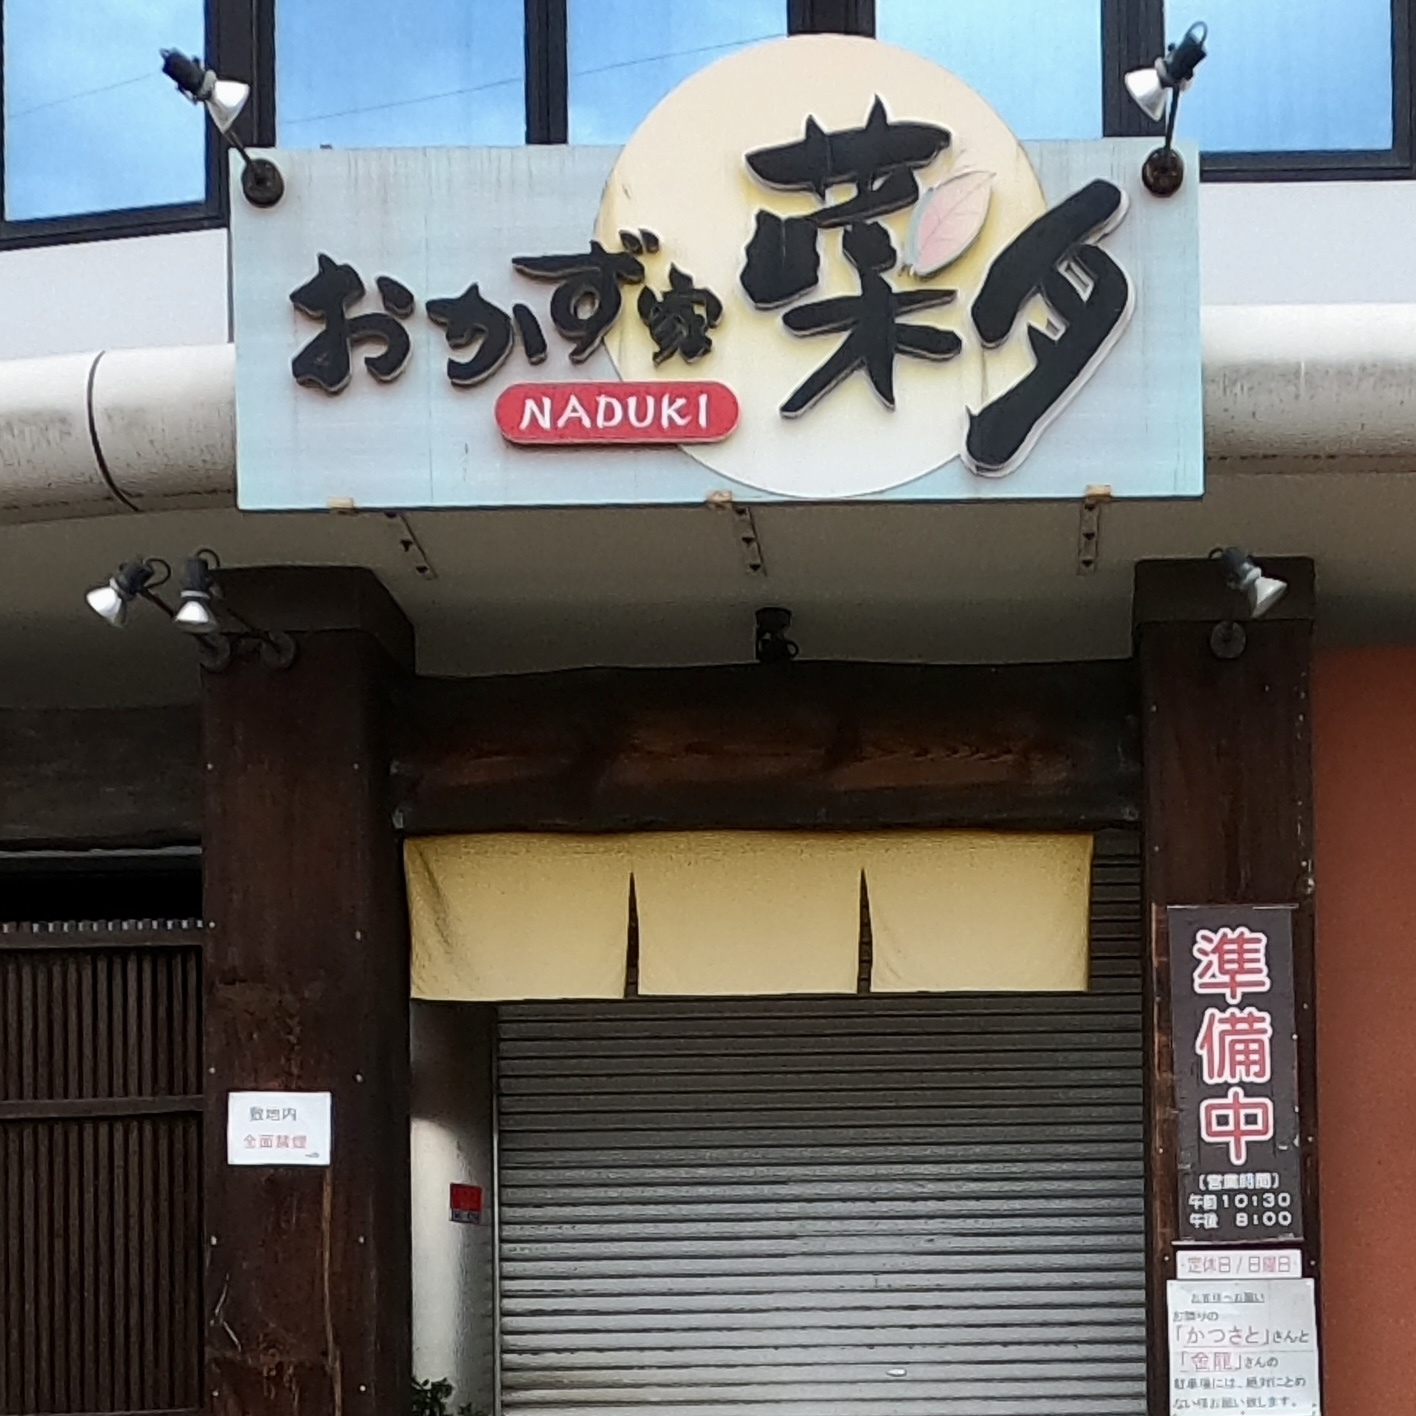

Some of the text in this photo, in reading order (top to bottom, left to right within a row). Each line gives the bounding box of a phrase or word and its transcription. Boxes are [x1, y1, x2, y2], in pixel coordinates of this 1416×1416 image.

[518, 393, 709, 430] NADUKI
[1192, 925, 1275, 1166] 準備中
